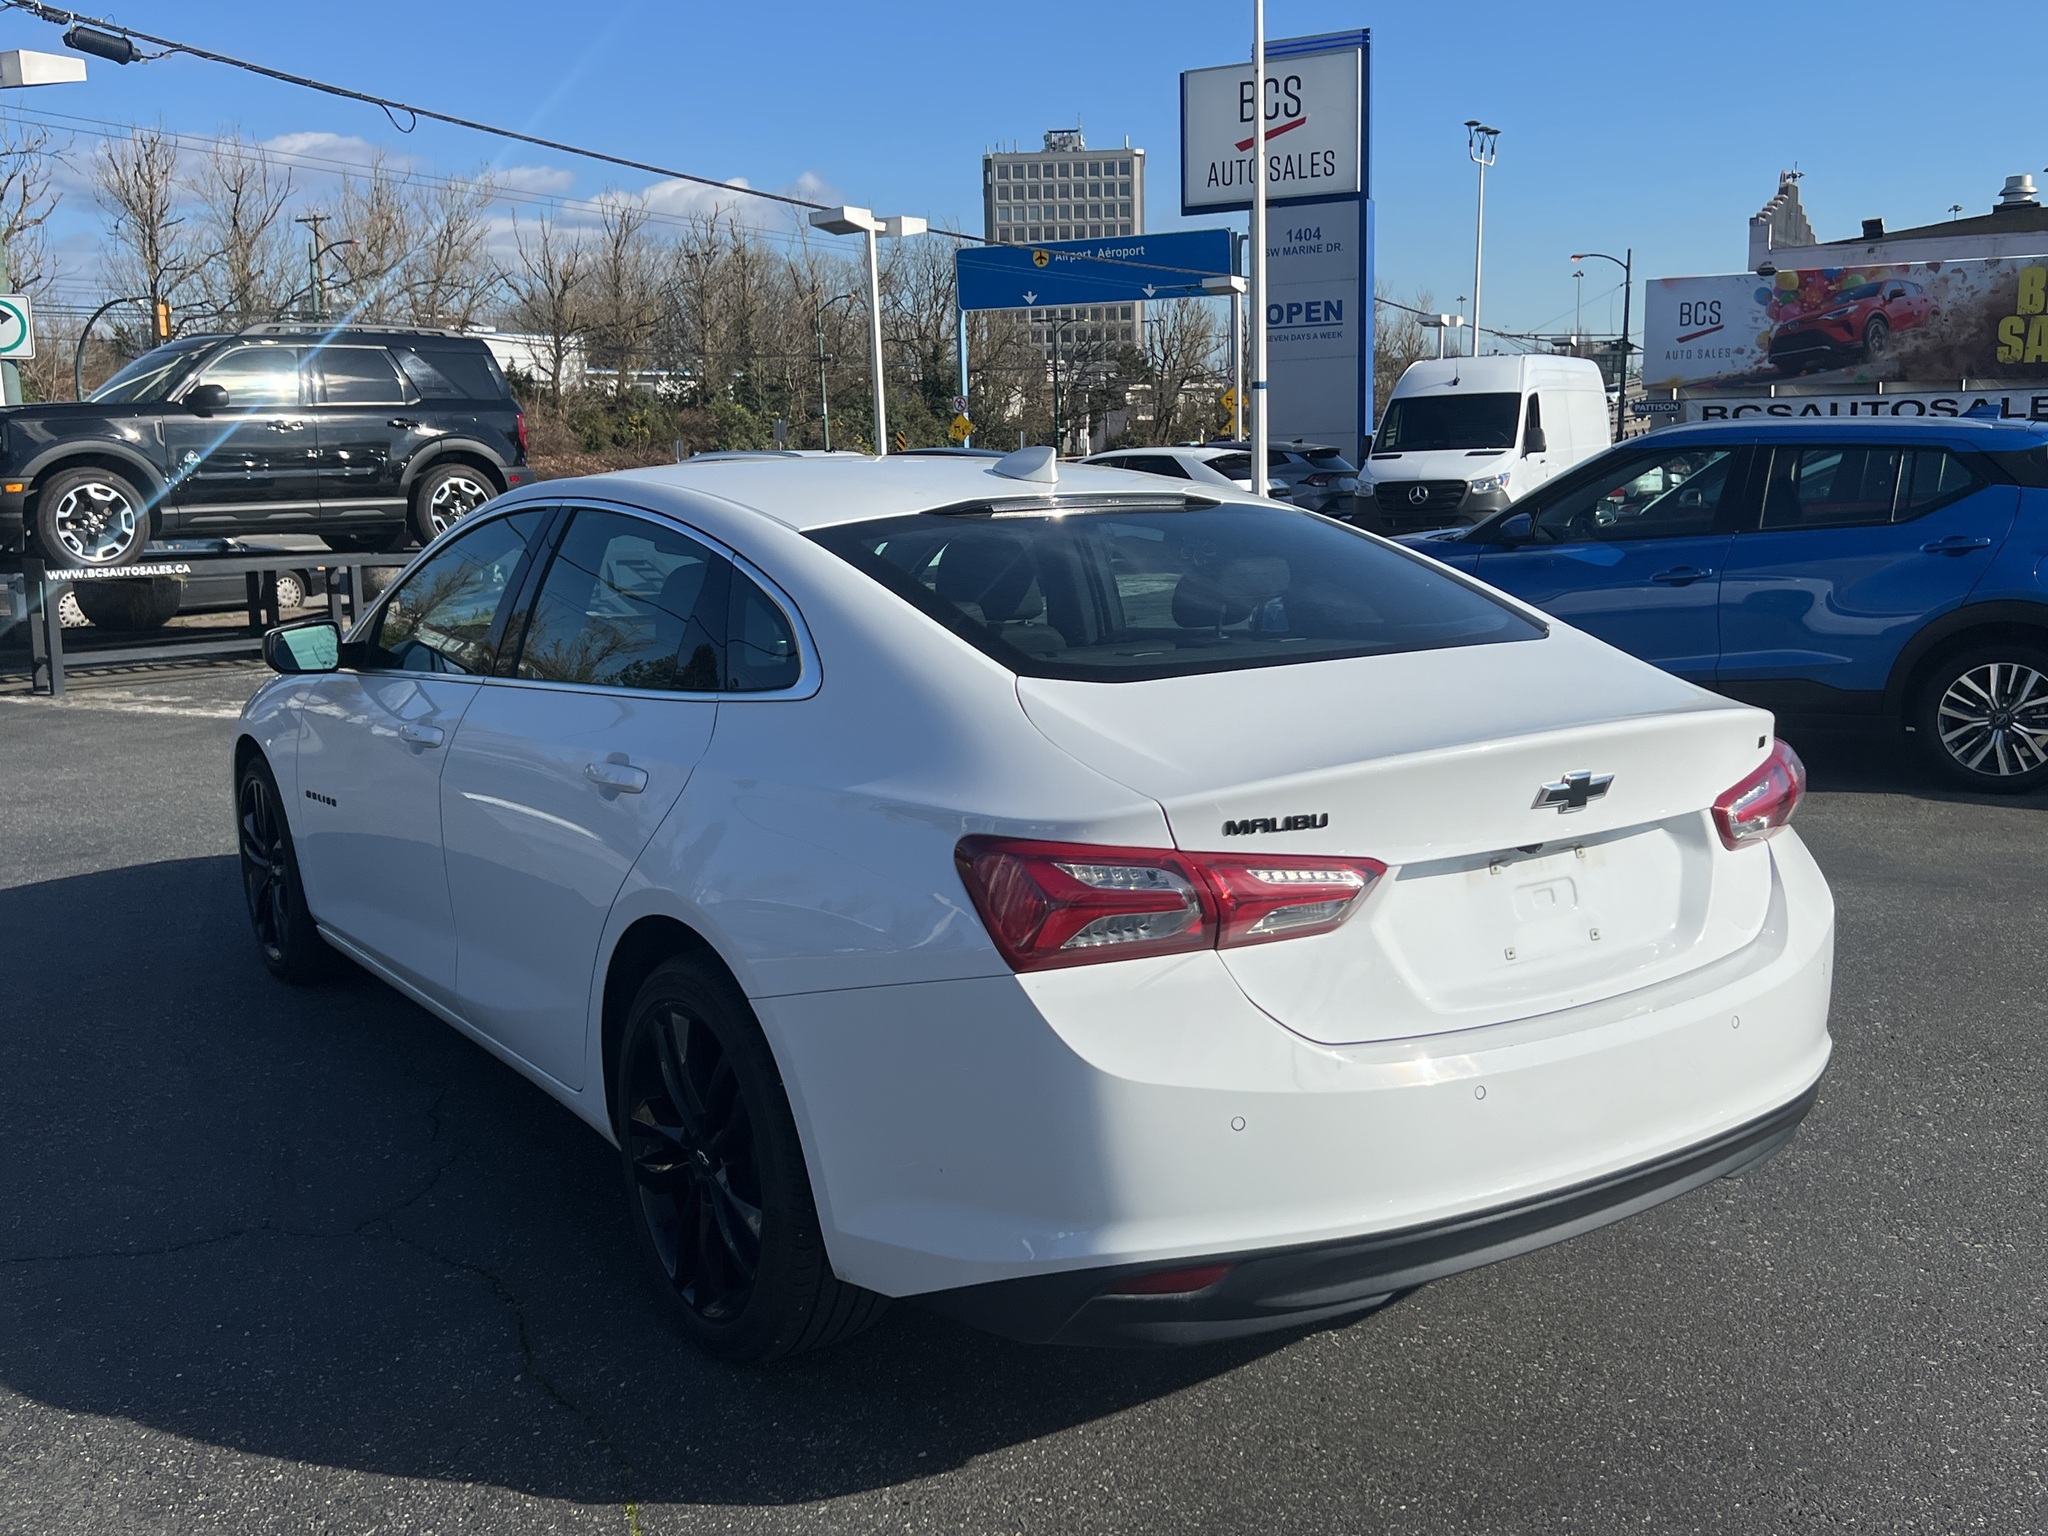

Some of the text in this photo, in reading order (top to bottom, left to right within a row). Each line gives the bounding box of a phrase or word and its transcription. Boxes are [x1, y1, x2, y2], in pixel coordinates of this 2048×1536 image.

[1240, 75, 1302, 123] BCS
[1269, 150, 1335, 182] SALES
[1286, 227, 1322, 243] 1404
[1055, 245, 1145, 263] Airport Aéroport
[1282, 244, 1323, 256] MARINE
[1326, 242, 1344, 253] DR.
[1266, 300, 1343, 325] OPEN
[1679, 300, 1721, 327] BCS
[1291, 332, 1311, 341] DAYS
[1320, 331, 1343, 339] WEEK
[1996, 314, 2048, 364] SA
[1665, 347, 1731, 360] AUTO SALES
[1634, 403, 1680, 412] PATTISON
[47, 564, 191, 580] WWW.BCSAUTOSALES.CA
[1221, 812, 1329, 837] MALIBU
